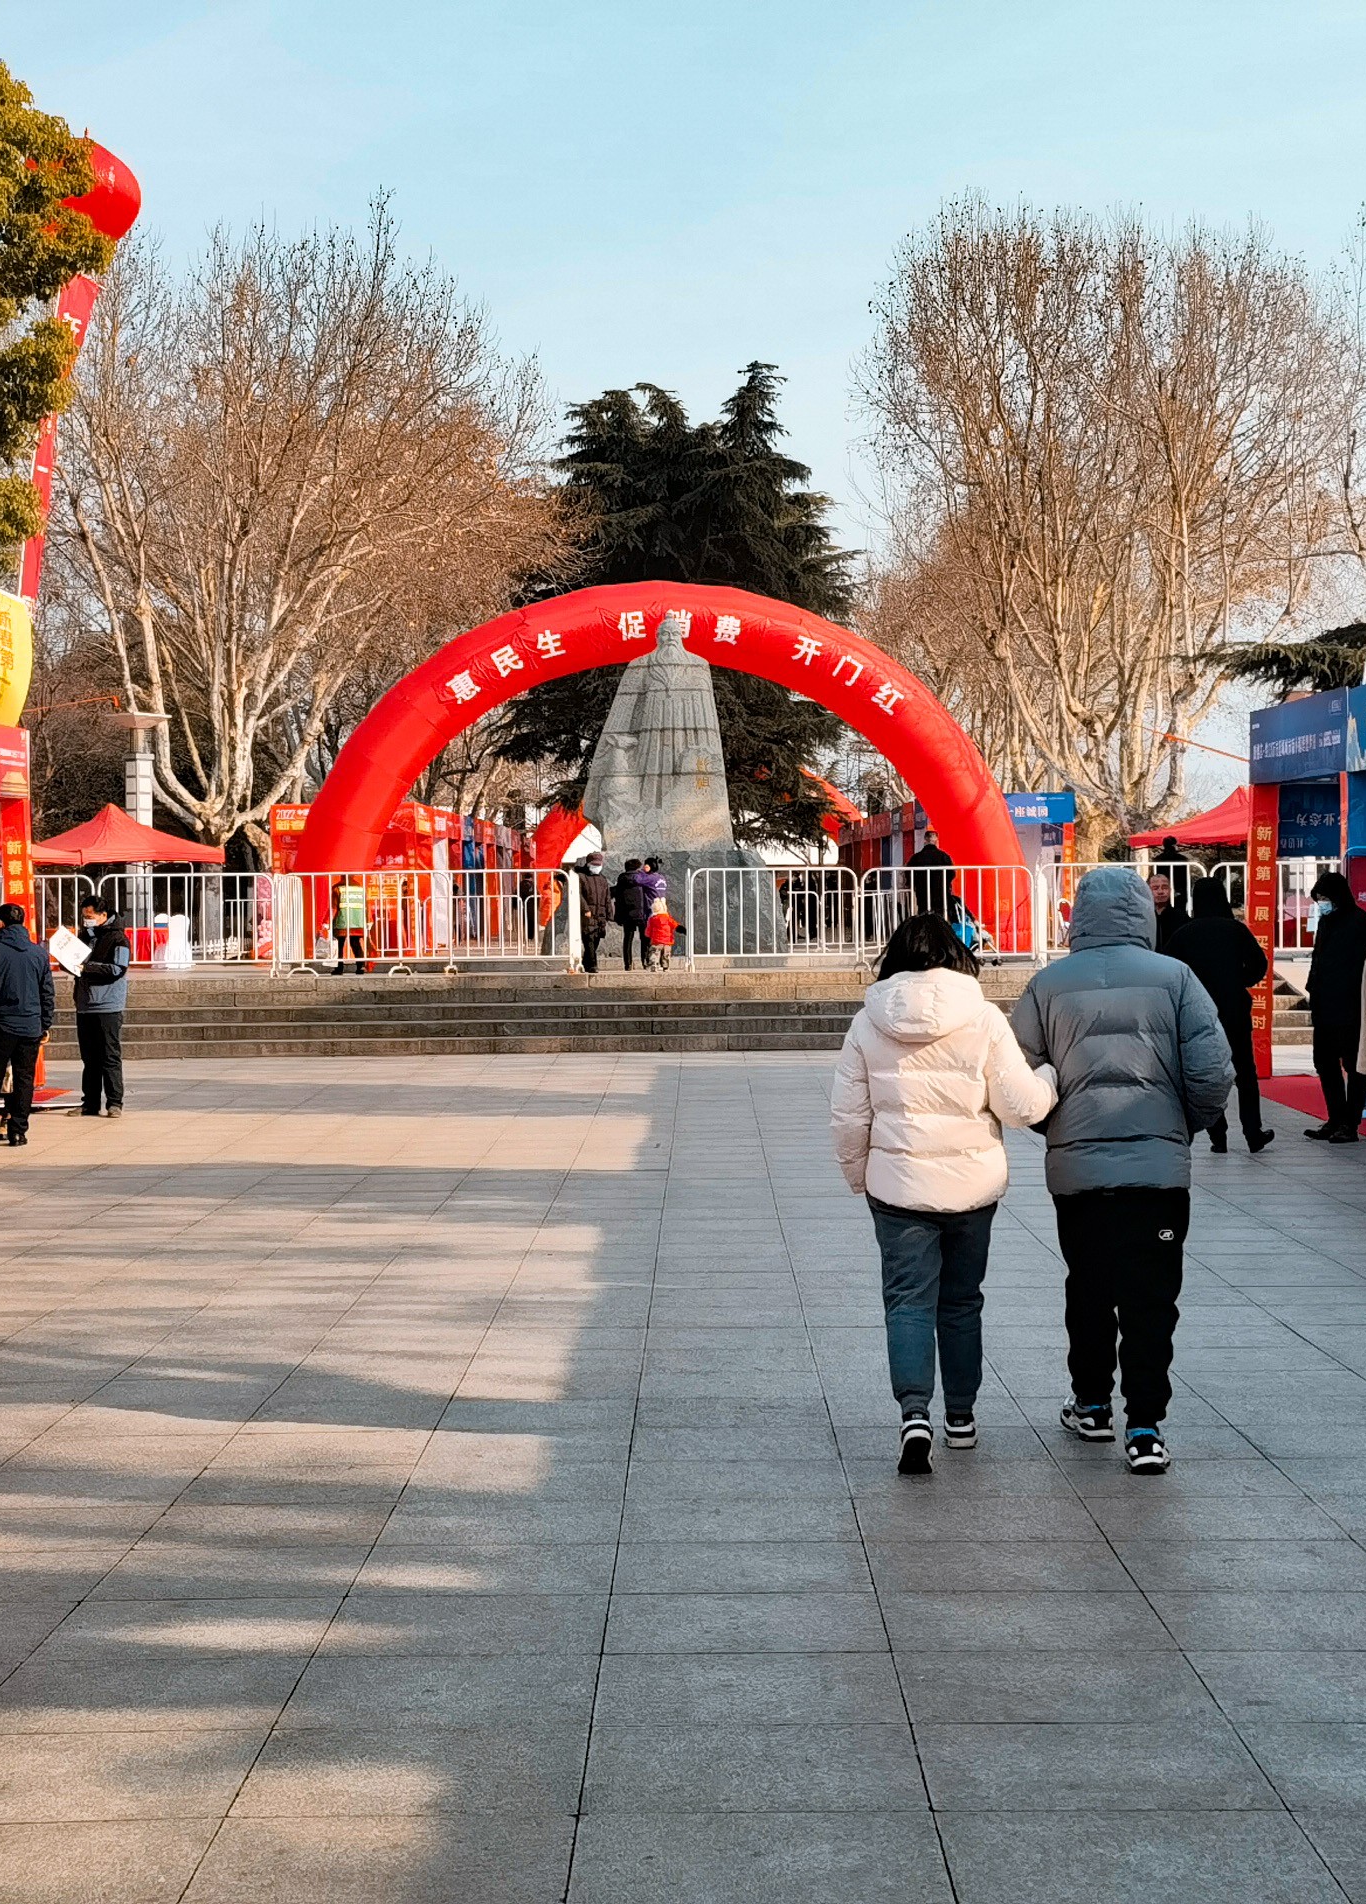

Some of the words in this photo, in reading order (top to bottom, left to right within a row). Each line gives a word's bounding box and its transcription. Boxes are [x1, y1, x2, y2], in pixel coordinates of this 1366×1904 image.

[445, 629, 567, 706] 惠民生
[790, 635, 906, 717] 开门红
